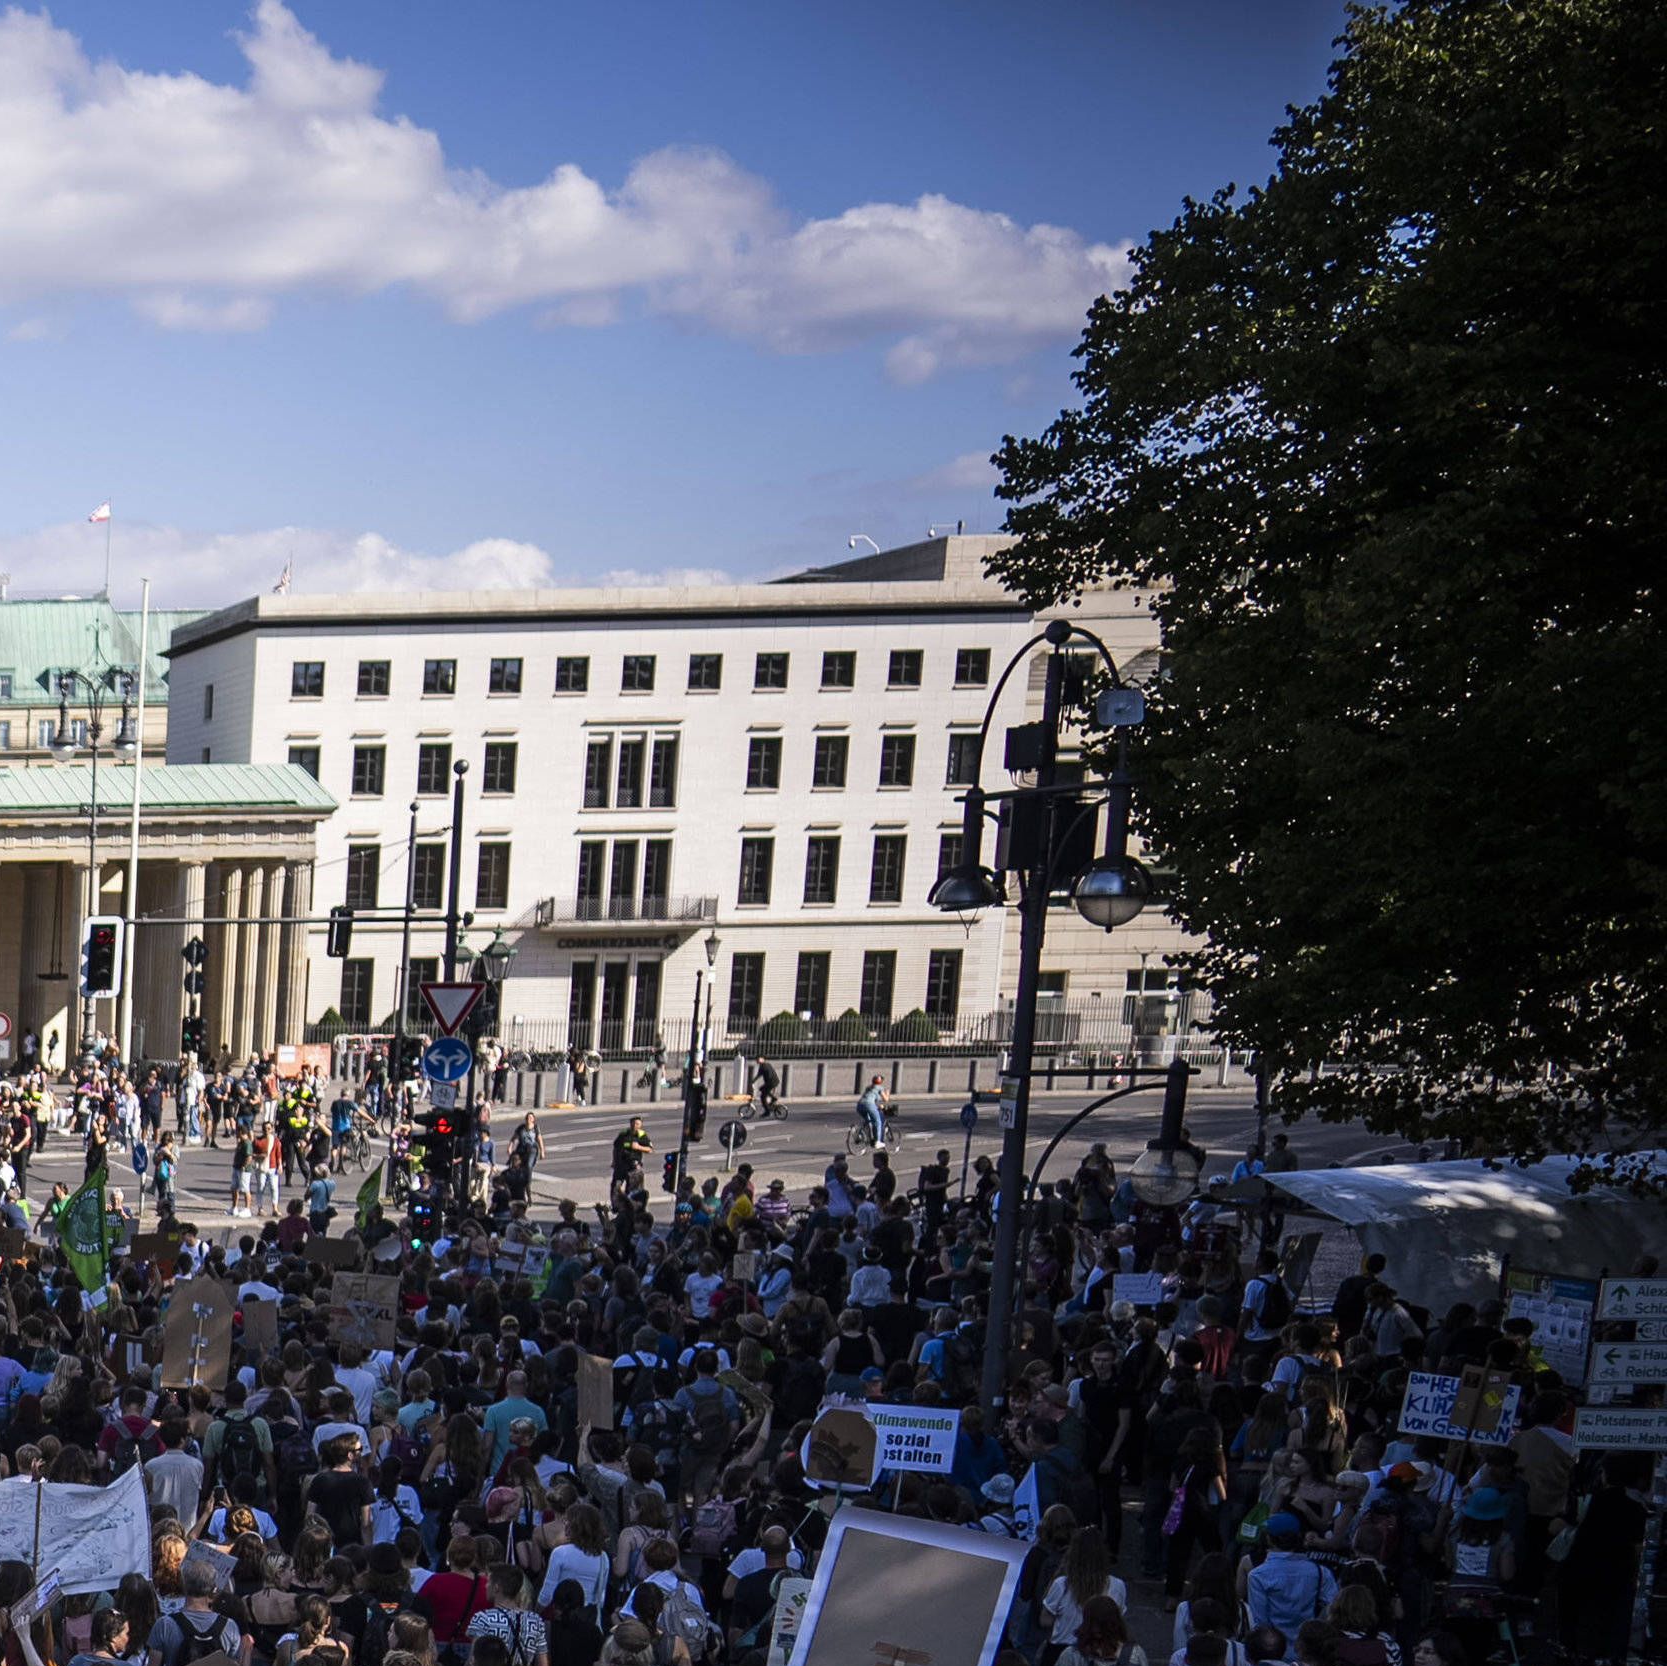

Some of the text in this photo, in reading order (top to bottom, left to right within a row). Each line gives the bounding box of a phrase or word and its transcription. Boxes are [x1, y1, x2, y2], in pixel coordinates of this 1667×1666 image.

[557, 936, 661, 949] COMMERZBANK
[1410, 1373, 1431, 1386] BIN
[1405, 1416, 1429, 1430] VON
[1595, 1415, 1654, 1427] Potsdamer
[886, 1433, 931, 1449] sozial
